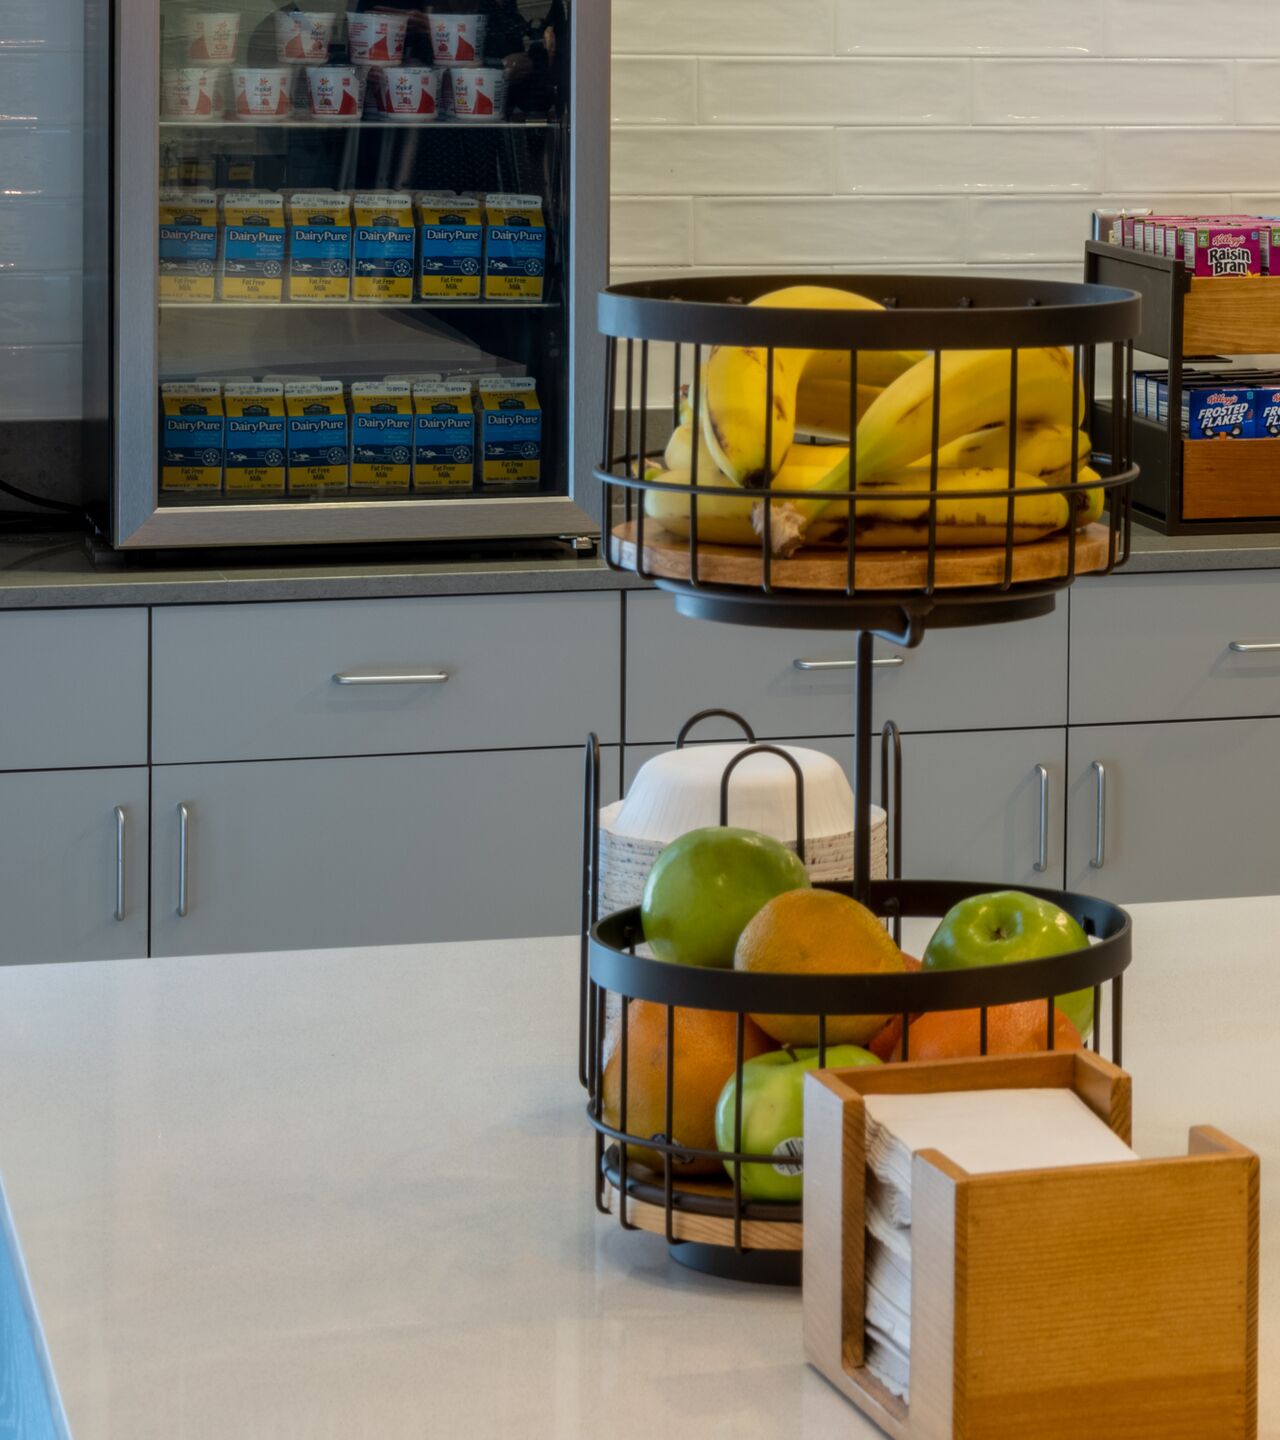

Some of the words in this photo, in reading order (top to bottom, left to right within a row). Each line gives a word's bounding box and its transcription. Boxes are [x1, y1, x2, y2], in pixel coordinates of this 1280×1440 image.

[160, 229, 215, 242] DairyPure
[229, 230, 282, 243] DairyPure
[295, 230, 347, 243] DairyPure
[359, 230, 411, 243] DairyPure
[427, 229, 479, 242] DairyPure
[491, 230, 542, 242] DairyPure
[1208, 247, 1251, 265] Raisin
[1213, 260, 1247, 276] Bran
[1198, 403, 1248, 419] FROSTED
[167, 420, 221, 433] DairyPure
[230, 421, 282, 433] DairyPure
[291, 420, 344, 433] DairyPure
[358, 418, 410, 431] DairyPure
[418, 418, 470, 430] DairyPure
[488, 415, 537, 427] DairyPure
[1201, 414, 1244, 428] FLAKES
